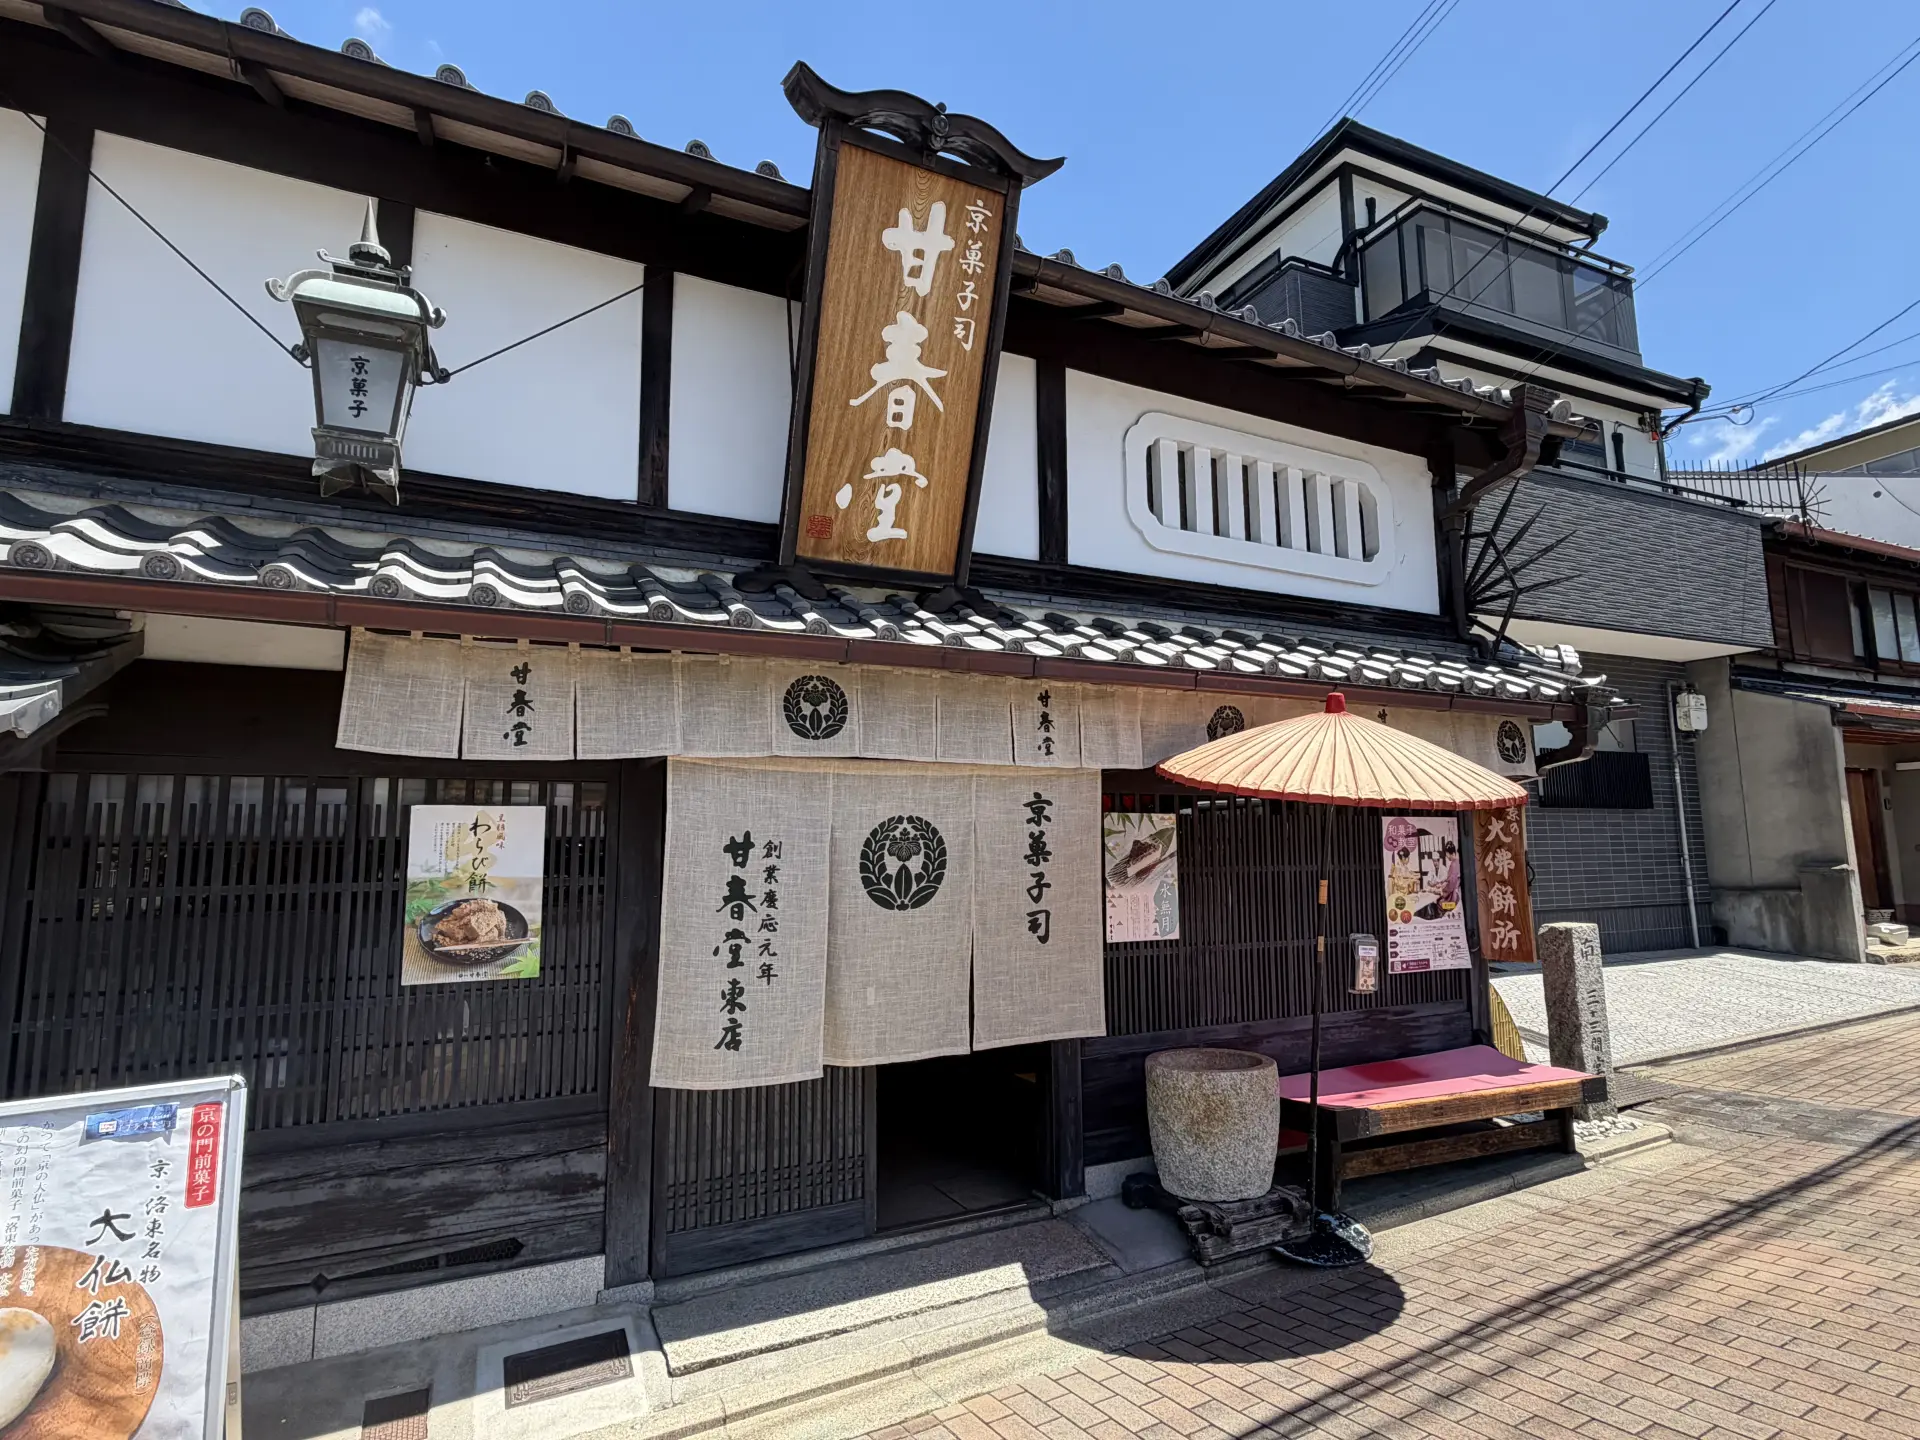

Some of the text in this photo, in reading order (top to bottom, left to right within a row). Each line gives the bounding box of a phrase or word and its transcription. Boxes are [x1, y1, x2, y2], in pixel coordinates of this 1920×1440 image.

[953, 199, 993, 351] 京菓子司
[348, 355, 370, 418] 京菓子
[835, 200, 955, 543] 甘春堂
[503, 661, 535, 747] 甘春堂
[1036, 689, 1056, 757] 甘春堂
[465, 814, 492, 894] わらび餅
[1023, 792, 1053, 945] 京菓子司
[1388, 823, 1414, 836] 和菓子
[1505, 807, 1520, 836] 京の
[755, 839, 782, 986] 創業慶応元年
[1160, 883, 1172, 932] 水無月
[1483, 816, 1522, 951] 大佛餅所
[712, 829, 758, 1053] 甘春堂東店
[190, 1106, 217, 1202] 京の門前菓子
[72, 1208, 138, 1343] 大仏餅
[139, 1160, 173, 1285] 京・洛東名物
